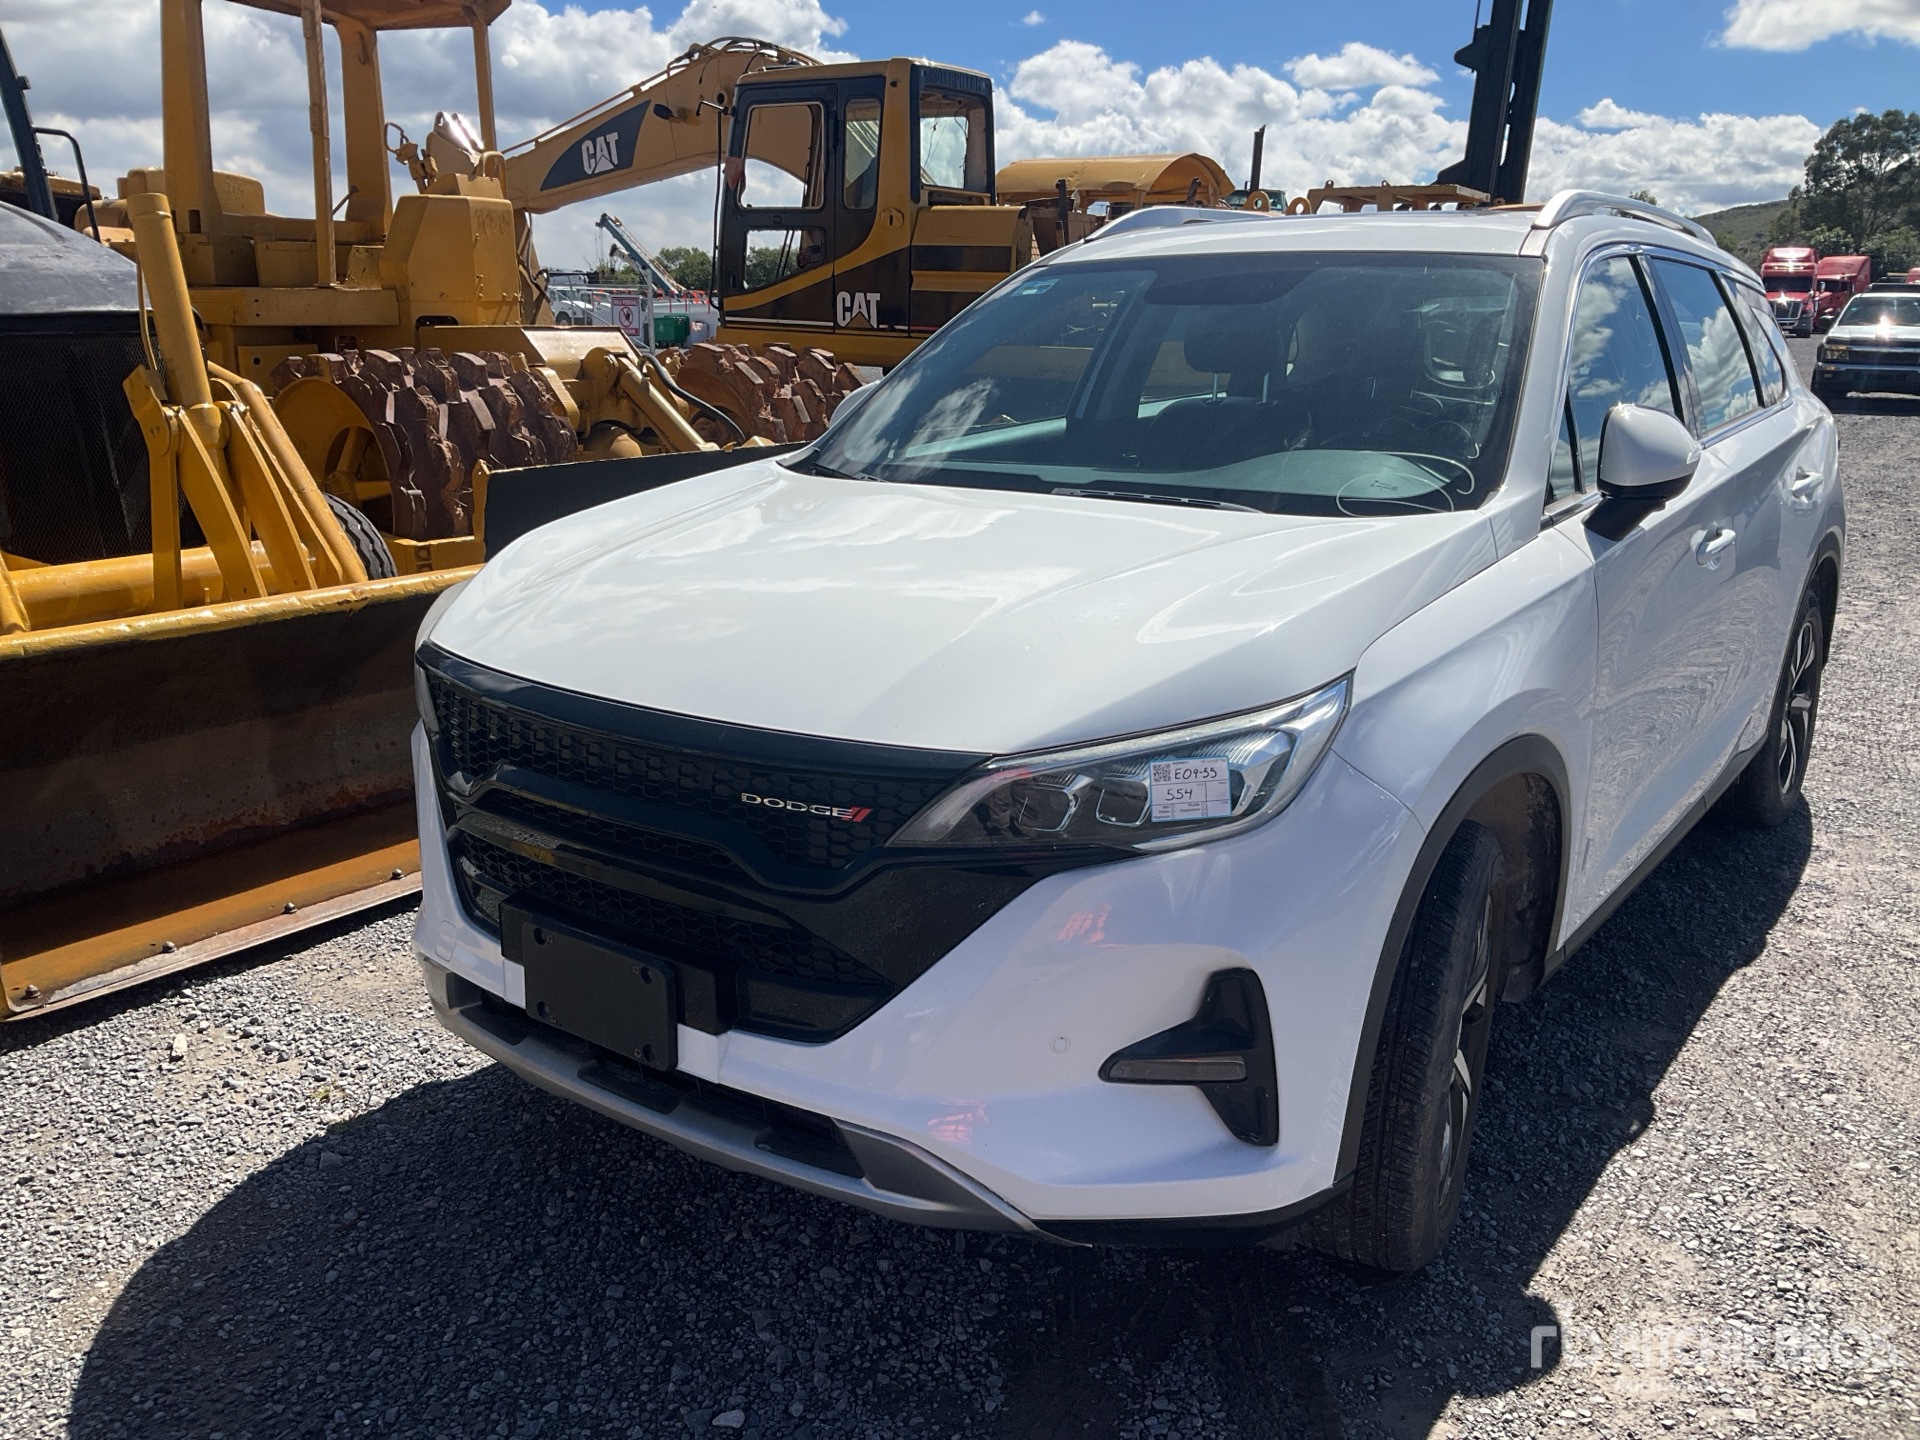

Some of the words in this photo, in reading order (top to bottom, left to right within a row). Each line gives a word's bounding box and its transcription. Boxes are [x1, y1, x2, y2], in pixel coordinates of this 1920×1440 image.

[581, 131, 619, 175] CAT
[836, 291, 881, 329] CAT
[741, 792, 853, 819] DODGE
[1165, 788, 1193, 801] 554
